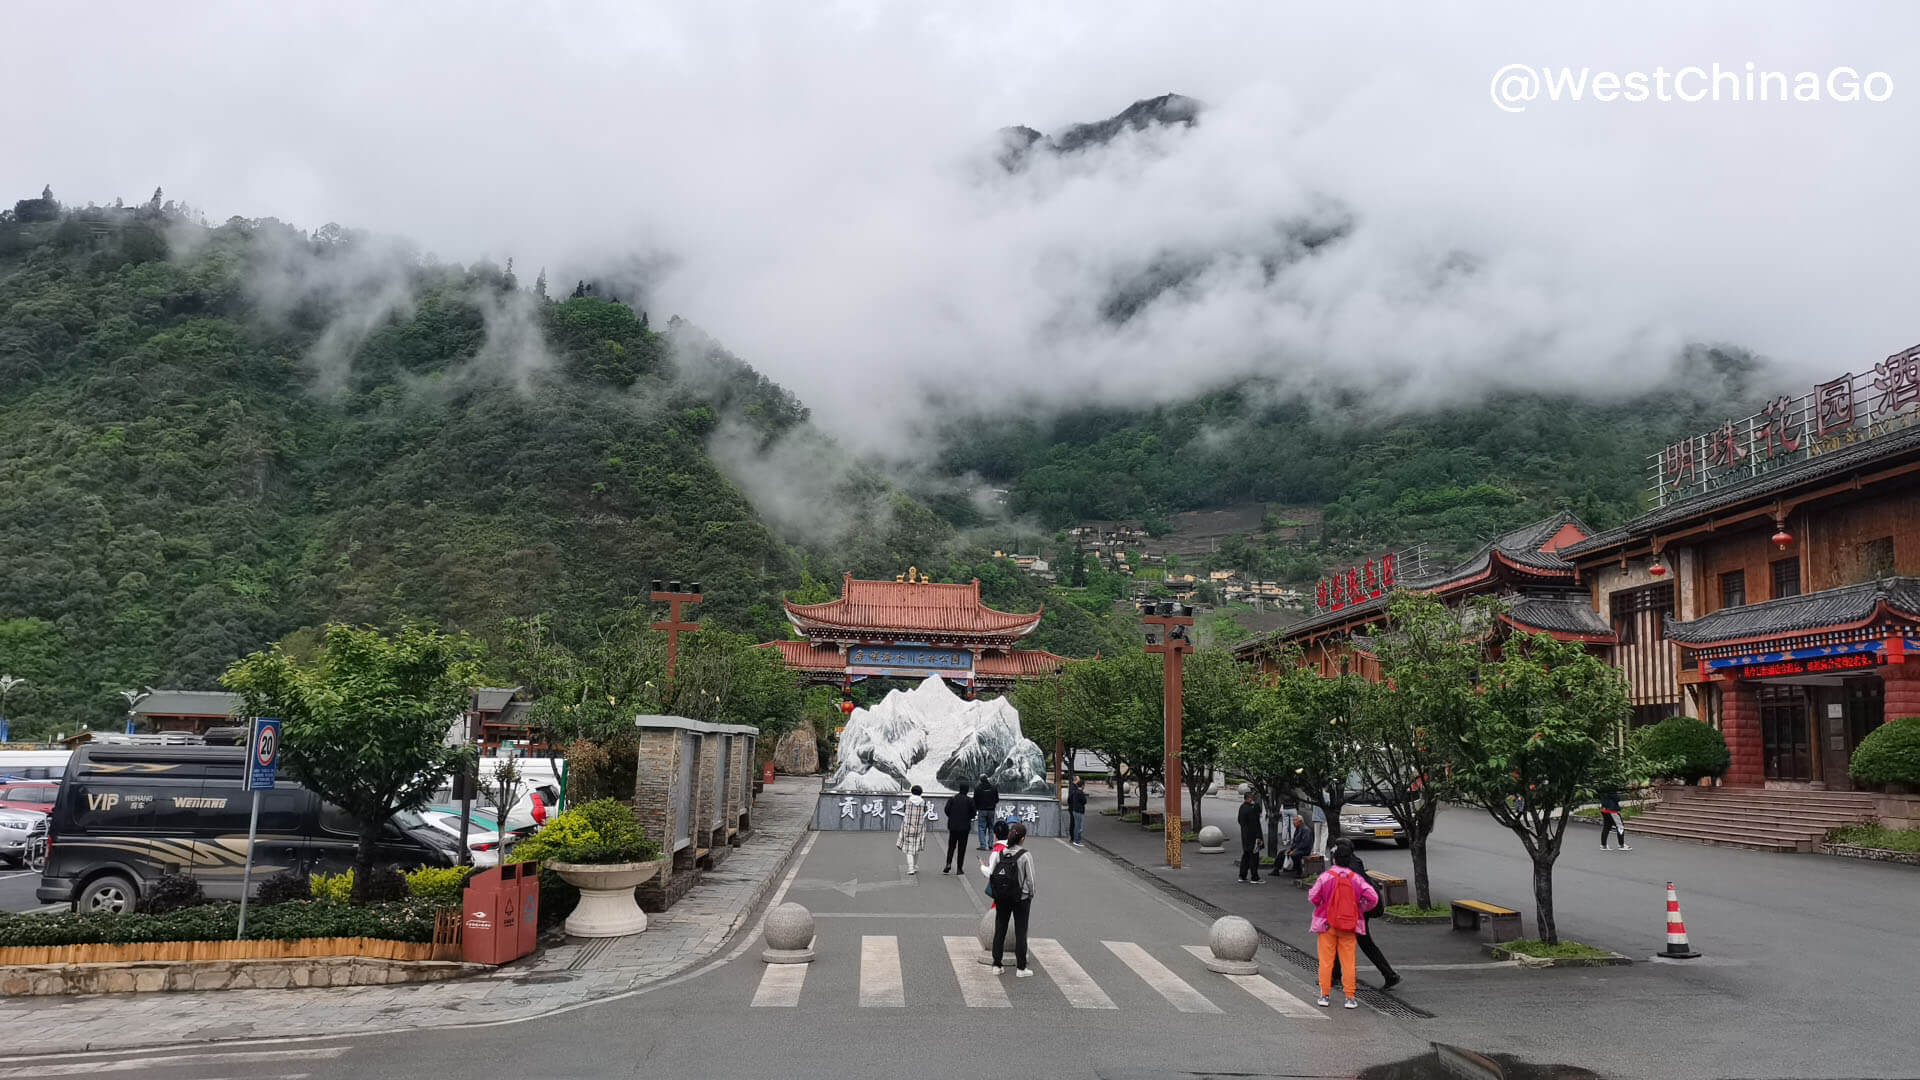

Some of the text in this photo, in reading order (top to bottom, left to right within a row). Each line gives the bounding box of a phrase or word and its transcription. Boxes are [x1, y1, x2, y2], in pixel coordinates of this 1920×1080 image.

[1665, 344, 1920, 488] 明珠花园酒
[261, 735, 273, 755] 20
[87, 793, 120, 811] VIP
